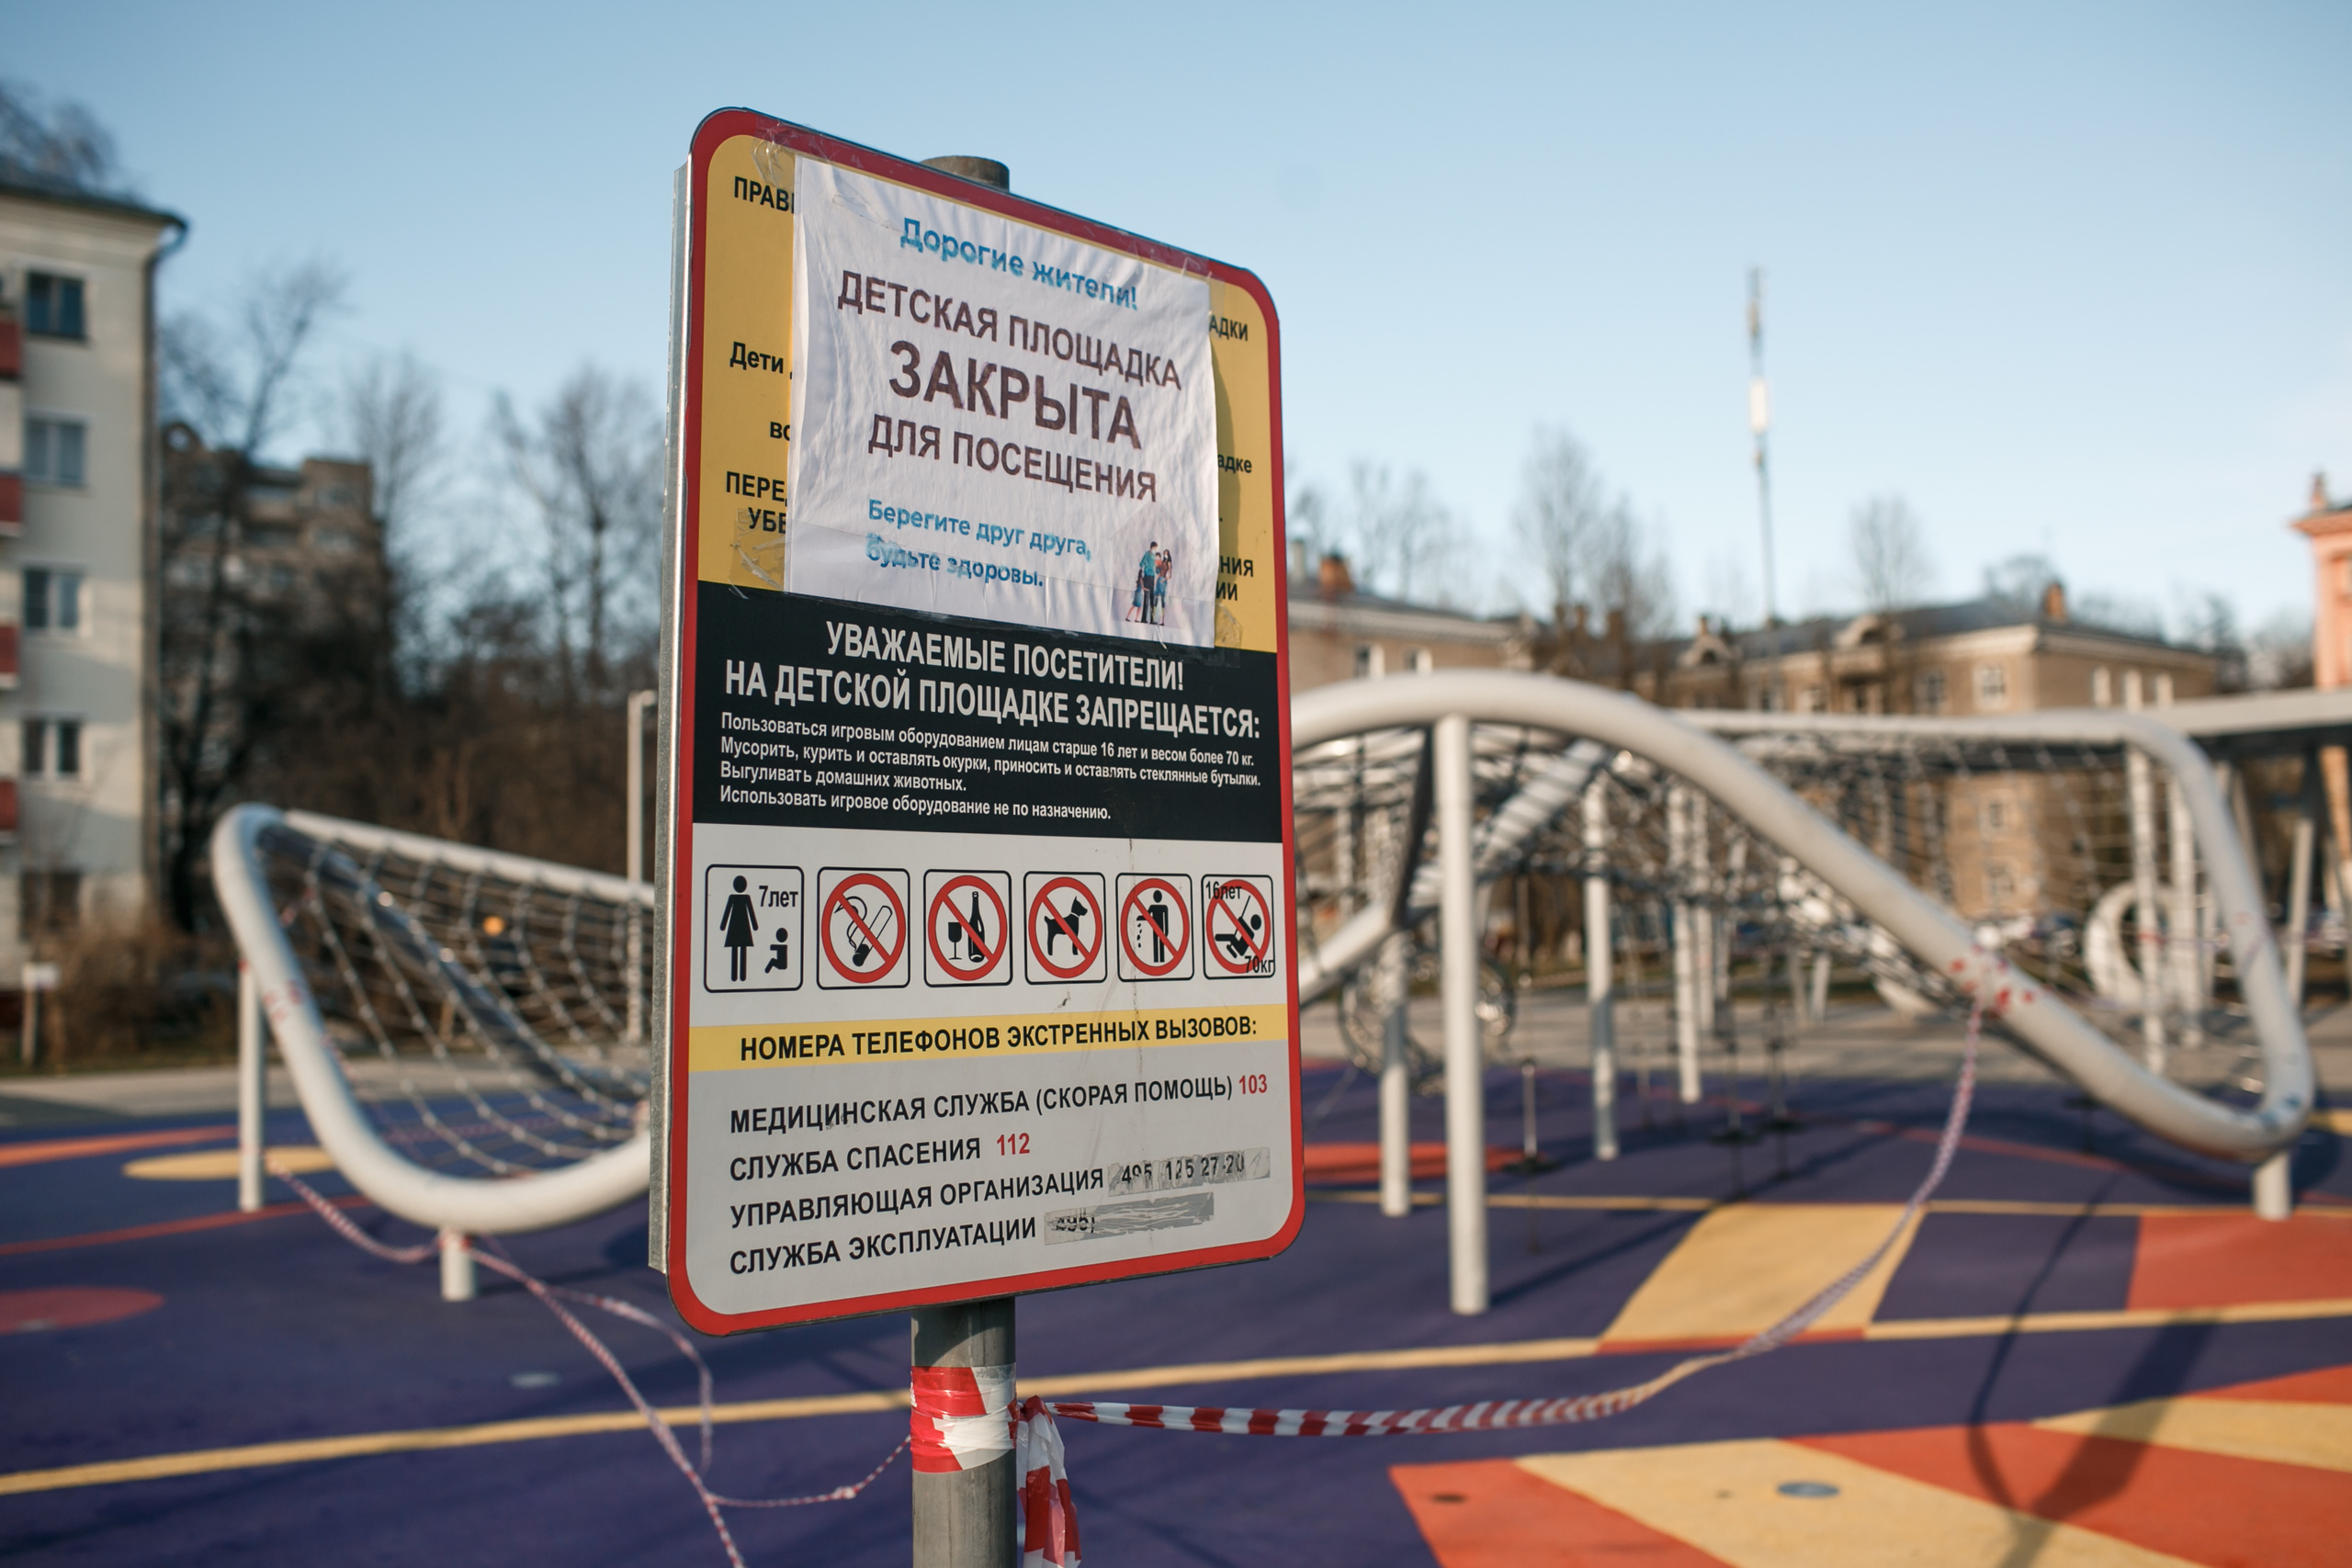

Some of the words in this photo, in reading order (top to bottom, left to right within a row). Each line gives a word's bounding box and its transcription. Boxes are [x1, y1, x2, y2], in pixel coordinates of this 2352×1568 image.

[734, 175, 795, 214] ПРАВ
[900, 217, 1023, 276] Дорогие
[1033, 261, 1138, 310] жители!
[838, 270, 998, 342] ДЕТСКАЯ
[1010, 314, 1182, 390] ПЛОЩАДКА
[729, 342, 784, 374] Дети
[889, 340, 1141, 449] ЗАКРЫТА
[868, 413, 940, 459] ДЛЯ
[953, 431, 1156, 502] ПОСЕЩЕНИЯ
[727, 471, 787, 507] ПЕРЕ
[868, 499, 970, 536] Берегите
[977, 522, 1024, 547] друг
[1030, 532, 1091, 561] друга,
[865, 533, 941, 570] будьте
[947, 558, 1044, 587] здоровы.
[1220, 556, 1253, 577] НИЯ
[827, 621, 1005, 672] УВАЖАЕМЫЕ
[1014, 643, 1183, 691] ПОСЕТИТЕЛИ!
[726, 660, 767, 697] НА
[775, 665, 910, 710] ДЕТСКОЙ
[920, 679, 1069, 727] ПЛОЩАДКЕ
[1076, 694, 1260, 739] ЗАПРЕЩАЕТСЯ:
[721, 712, 827, 736] Пользоваться
[831, 723, 895, 741] игровым
[899, 728, 1005, 750] оборудованием
[1008, 738, 1049, 754] лицам
[1052, 740, 1097, 758] старше
[1101, 742, 1114, 758] 16
[1117, 748, 1137, 761] лет
[1140, 749, 1148, 761] и
[1151, 750, 1187, 761] весом
[1190, 749, 1224, 764] более
[1227, 750, 1239, 765] 70
[1242, 754, 1254, 766] кг.
[721, 737, 798, 761] Мусорить,
[803, 746, 852, 763] курить
[856, 750, 865, 762] и
[869, 750, 940, 767] оставлять
[943, 756, 990, 773] окурки,
[994, 759, 1061, 775] приносить
[1064, 764, 1072, 775] и
[1075, 764, 1137, 779] оставлять
[1139, 768, 1208, 784] стеклянные
[1211, 769, 1261, 787] бутылки.
[720, 761, 812, 784] Выгуливать
[816, 771, 890, 787] домашних
[893, 774, 967, 791] животных.
[720, 785, 827, 807] Использовать
[831, 795, 888, 812] игровое
[892, 795, 990, 816] оборудование
[994, 803, 1009, 816] не
[1012, 804, 1028, 816] по
[1032, 804, 1111, 819] назначению.
[759, 886, 798, 908] 7лет
[1205, 881, 1242, 899] 16лет
[741, 1033, 845, 1061] НОМЕРА
[852, 1027, 1000, 1055] ТЕЛЕФОНОВ
[1007, 1020, 1149, 1048] ЭКСТРЕННЫХ
[1156, 1015, 1257, 1040] ВЫЗОВОВ:
[730, 1097, 926, 1135] МЕДИЦИНСКАЯ
[933, 1090, 1030, 1118] СЛУЖБА
[1036, 1083, 1127, 1115] (СКОРАЯ
[1135, 1076, 1232, 1103] ПОМОЩЬ)
[1239, 1074, 1268, 1095] 103
[729, 1149, 839, 1181] СЛУЖБА
[846, 1137, 981, 1170] СПАСЕНИЯ
[996, 1133, 1030, 1156] 112
[730, 1186, 933, 1229] УПРАВЛЯЮЩАЯ
[940, 1168, 1103, 1205] ОРГАНИЗАЦИЯ
[729, 1240, 841, 1274] СЛУЖБА
[848, 1217, 1035, 1259] ЭКСПЛУАТАЦИИ
